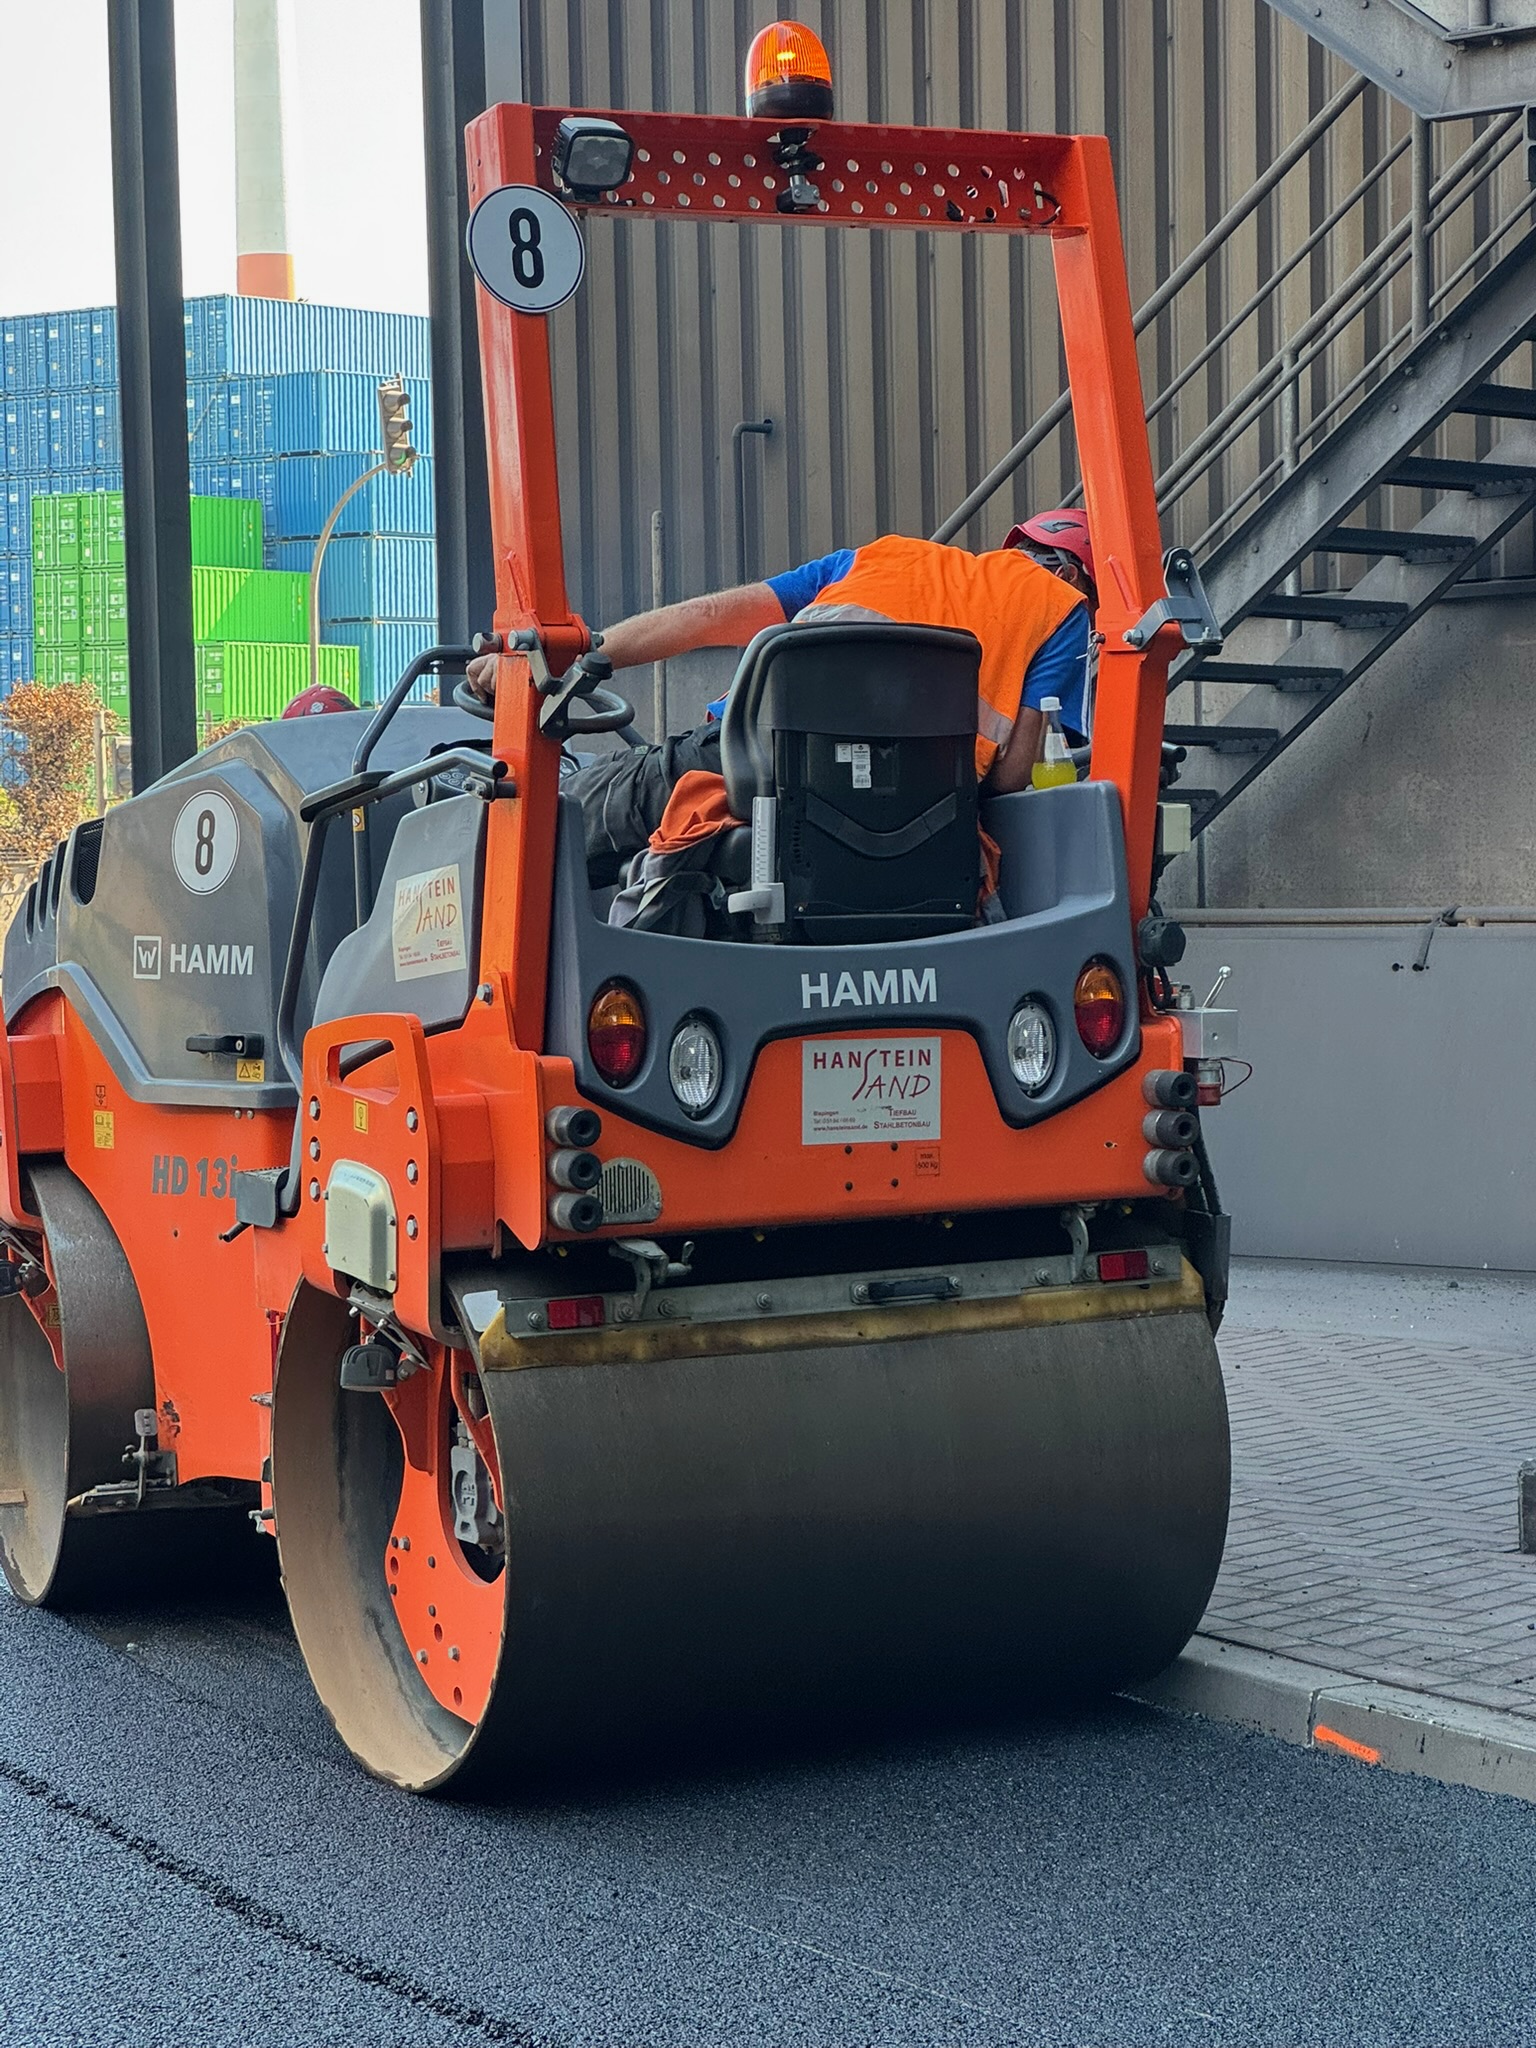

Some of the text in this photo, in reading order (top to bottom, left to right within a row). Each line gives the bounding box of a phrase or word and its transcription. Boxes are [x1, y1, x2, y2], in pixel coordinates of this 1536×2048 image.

[509, 207, 545, 289] 8
[195, 809, 215, 876] 8
[170, 943, 254, 976] HAMM
[801, 967, 937, 1009] HAMM
[813, 1048, 931, 1070] HANSTEIN
[852, 1073, 931, 1101] SAND
[874, 1120, 931, 1130] STAHLBETONBAU
[888, 1108, 917, 1117] TIEFBAU
[152, 1154, 238, 1200] HD 13i
